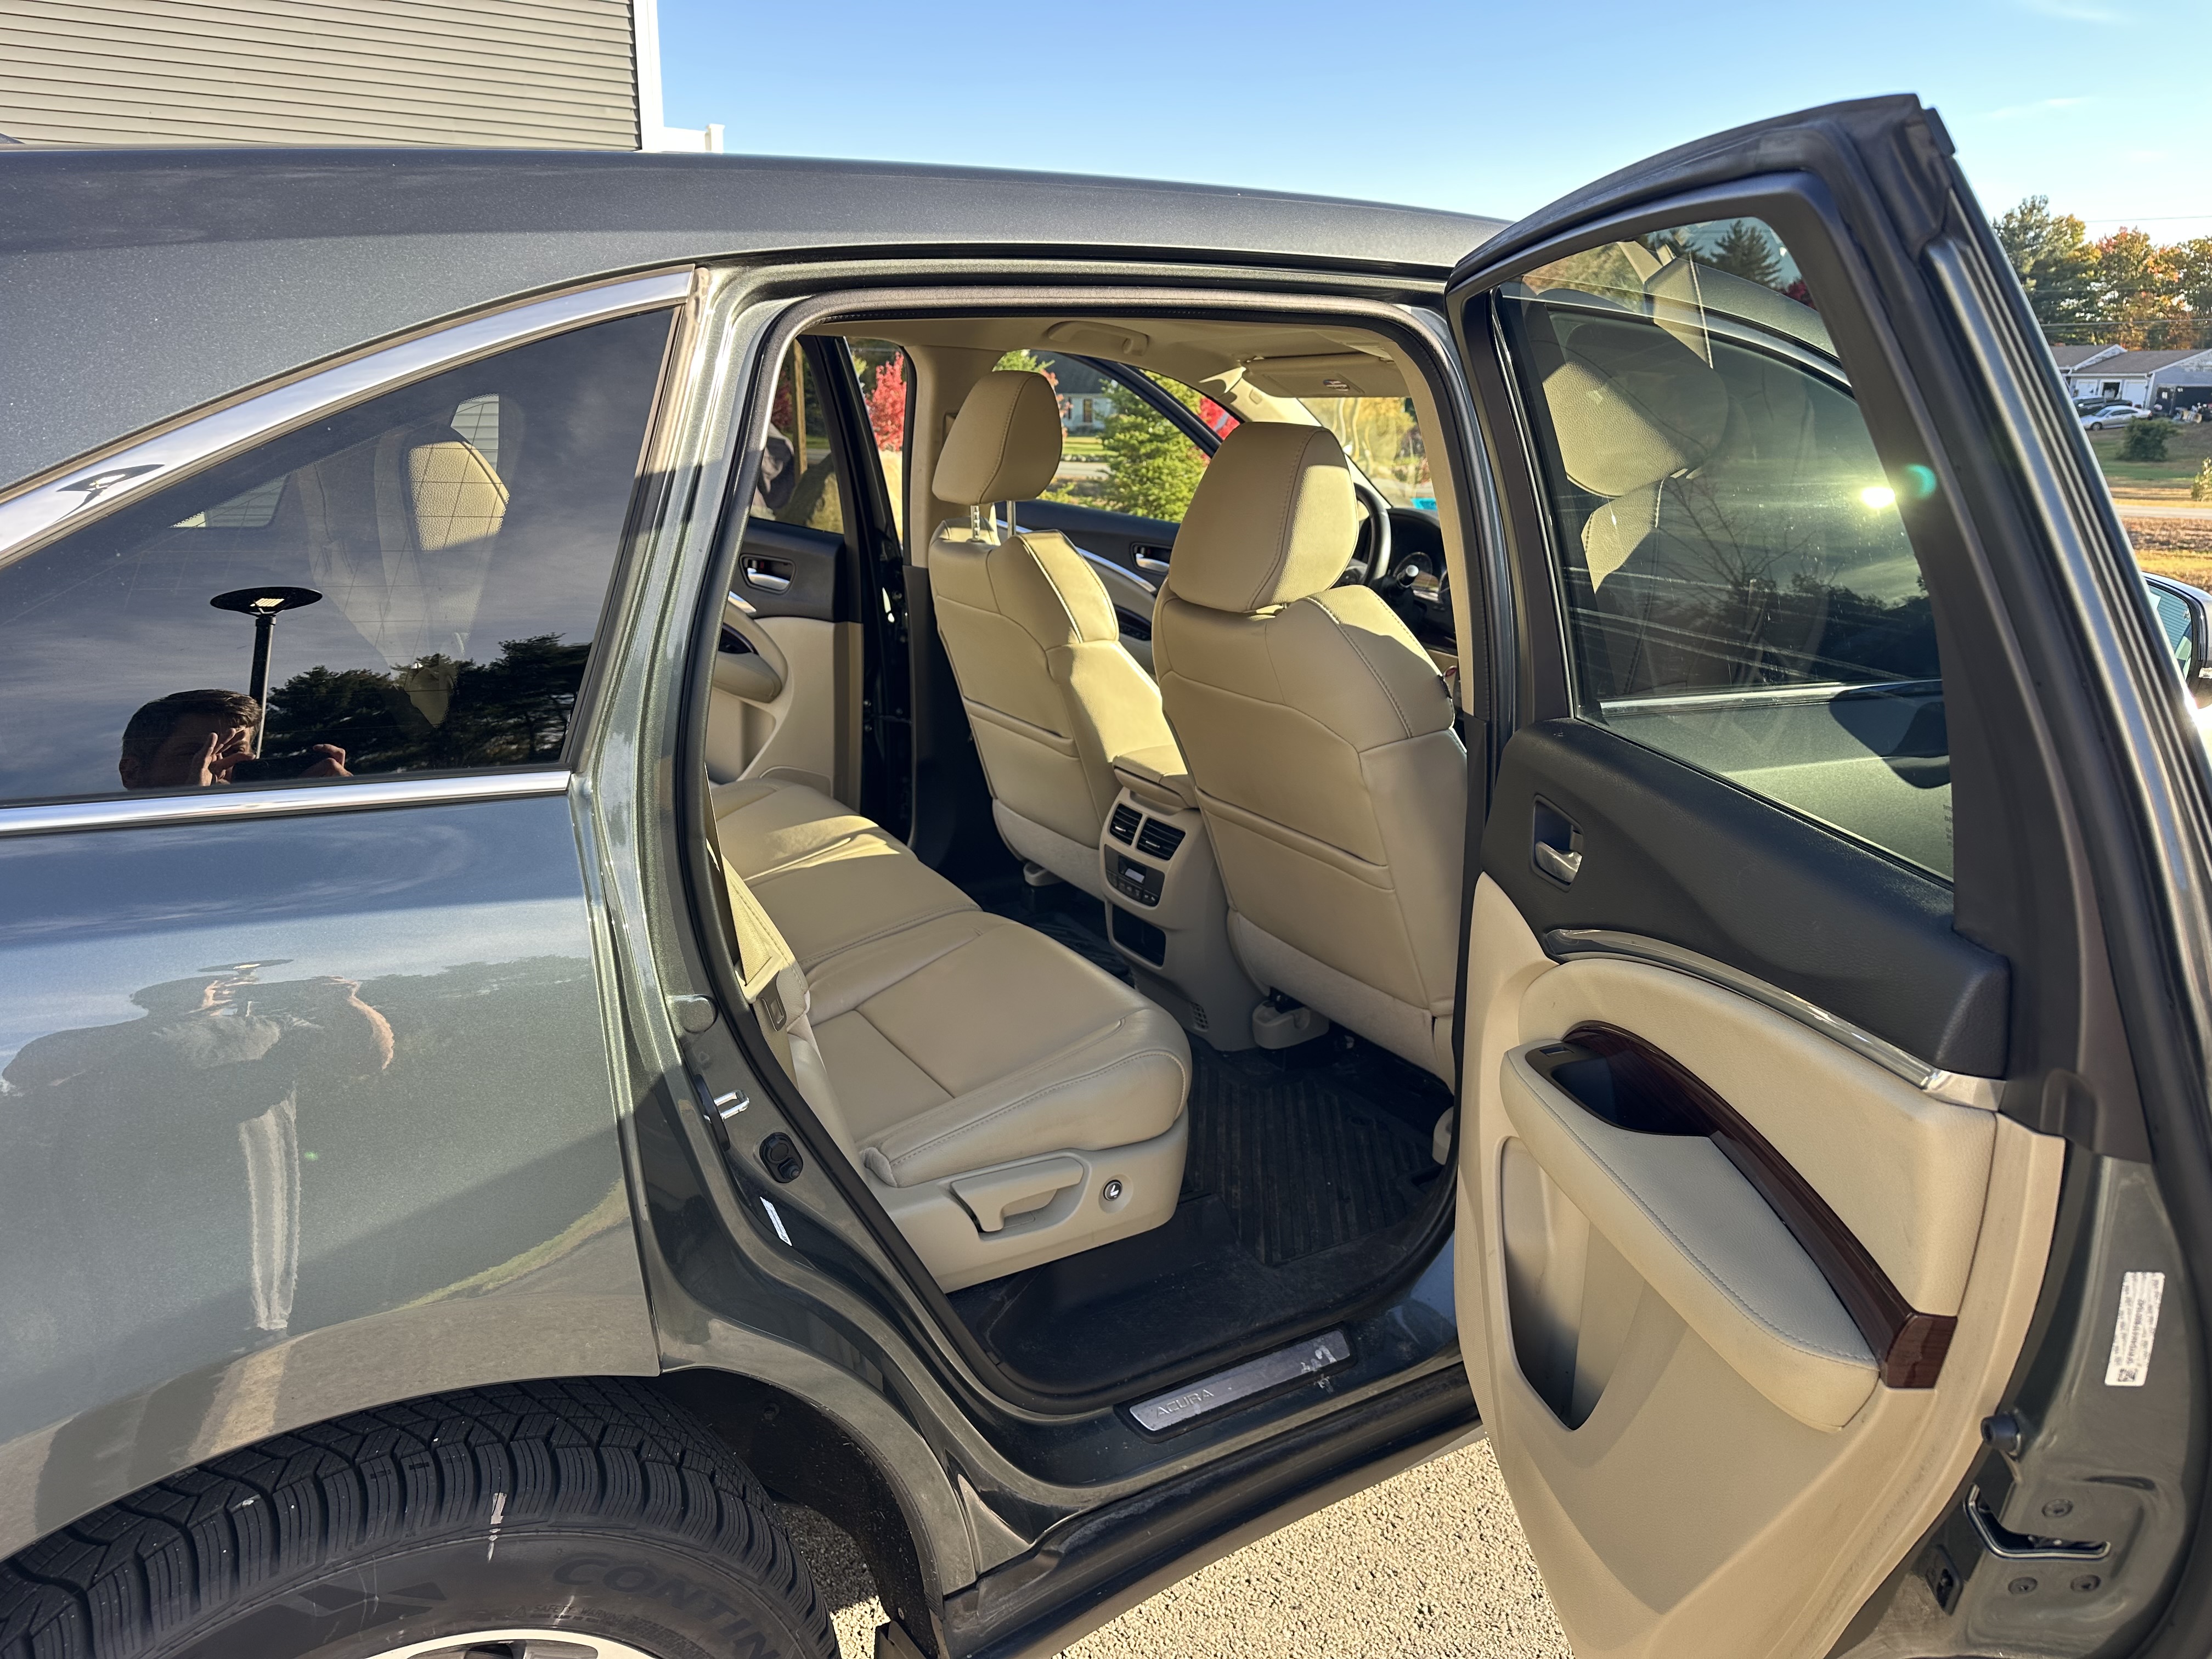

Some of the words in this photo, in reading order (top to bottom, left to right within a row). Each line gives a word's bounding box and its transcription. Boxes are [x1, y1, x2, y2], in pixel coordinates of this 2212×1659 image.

[1156, 1389, 1215, 1418] ACURA
[533, 1604, 576, 1613] SAFETY
[581, 1606, 627, 1622] WARNING
